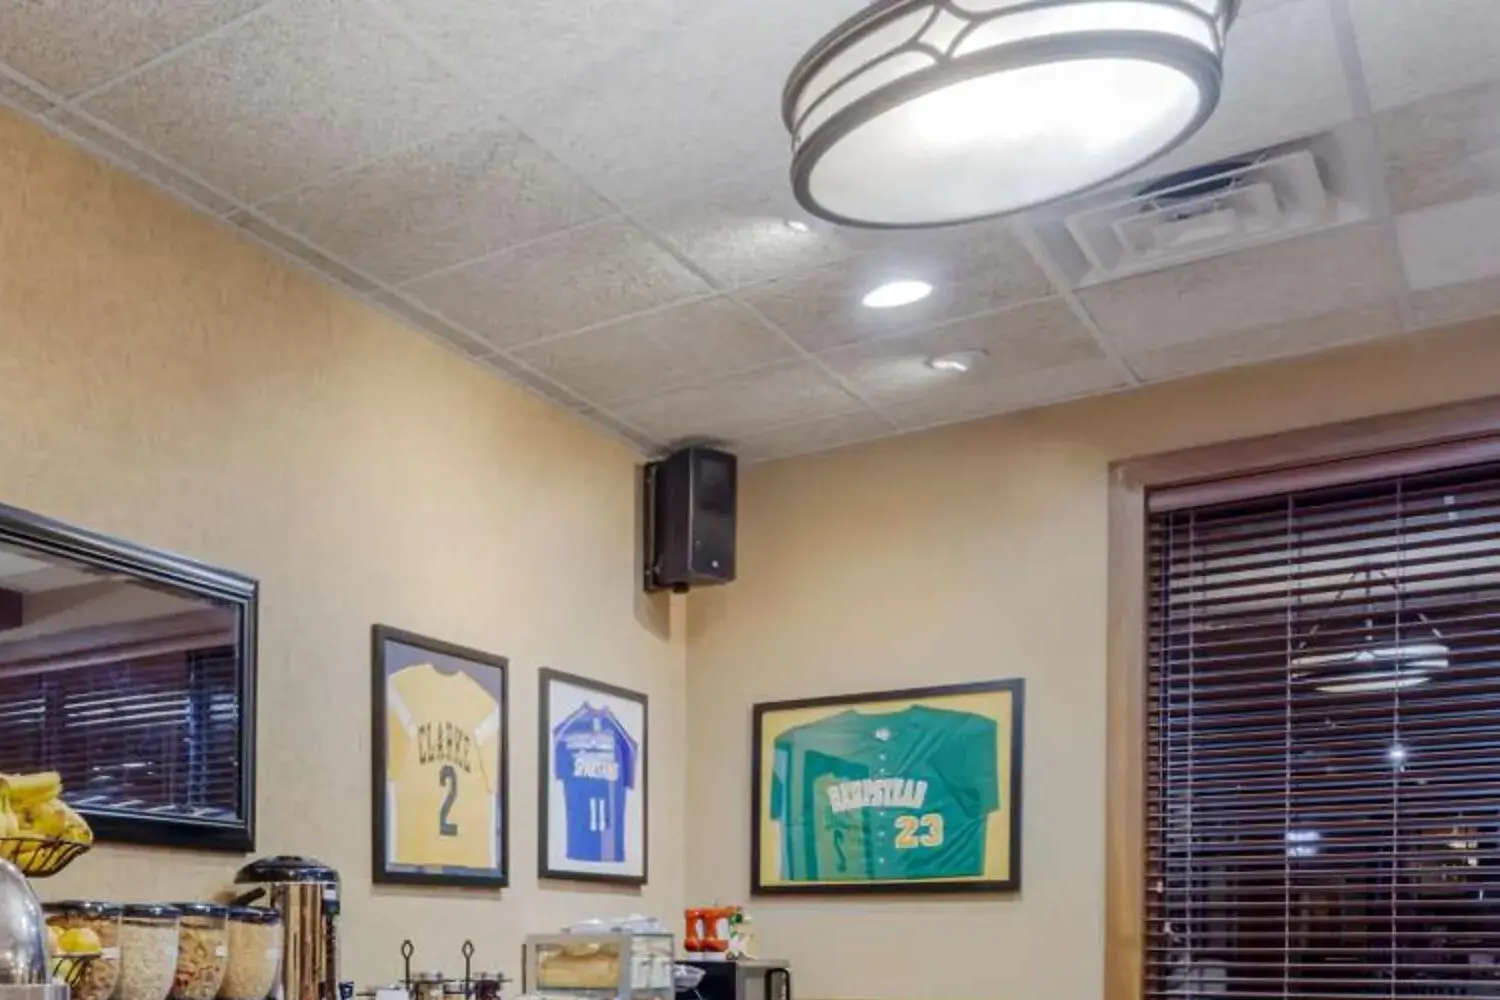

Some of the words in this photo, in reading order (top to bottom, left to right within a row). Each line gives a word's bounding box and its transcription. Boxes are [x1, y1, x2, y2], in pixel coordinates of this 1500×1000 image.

[418, 721, 470, 772] CLARKE
[439, 765, 458, 836] 2
[589, 797, 607, 832] 11
[894, 812, 944, 849] 23
